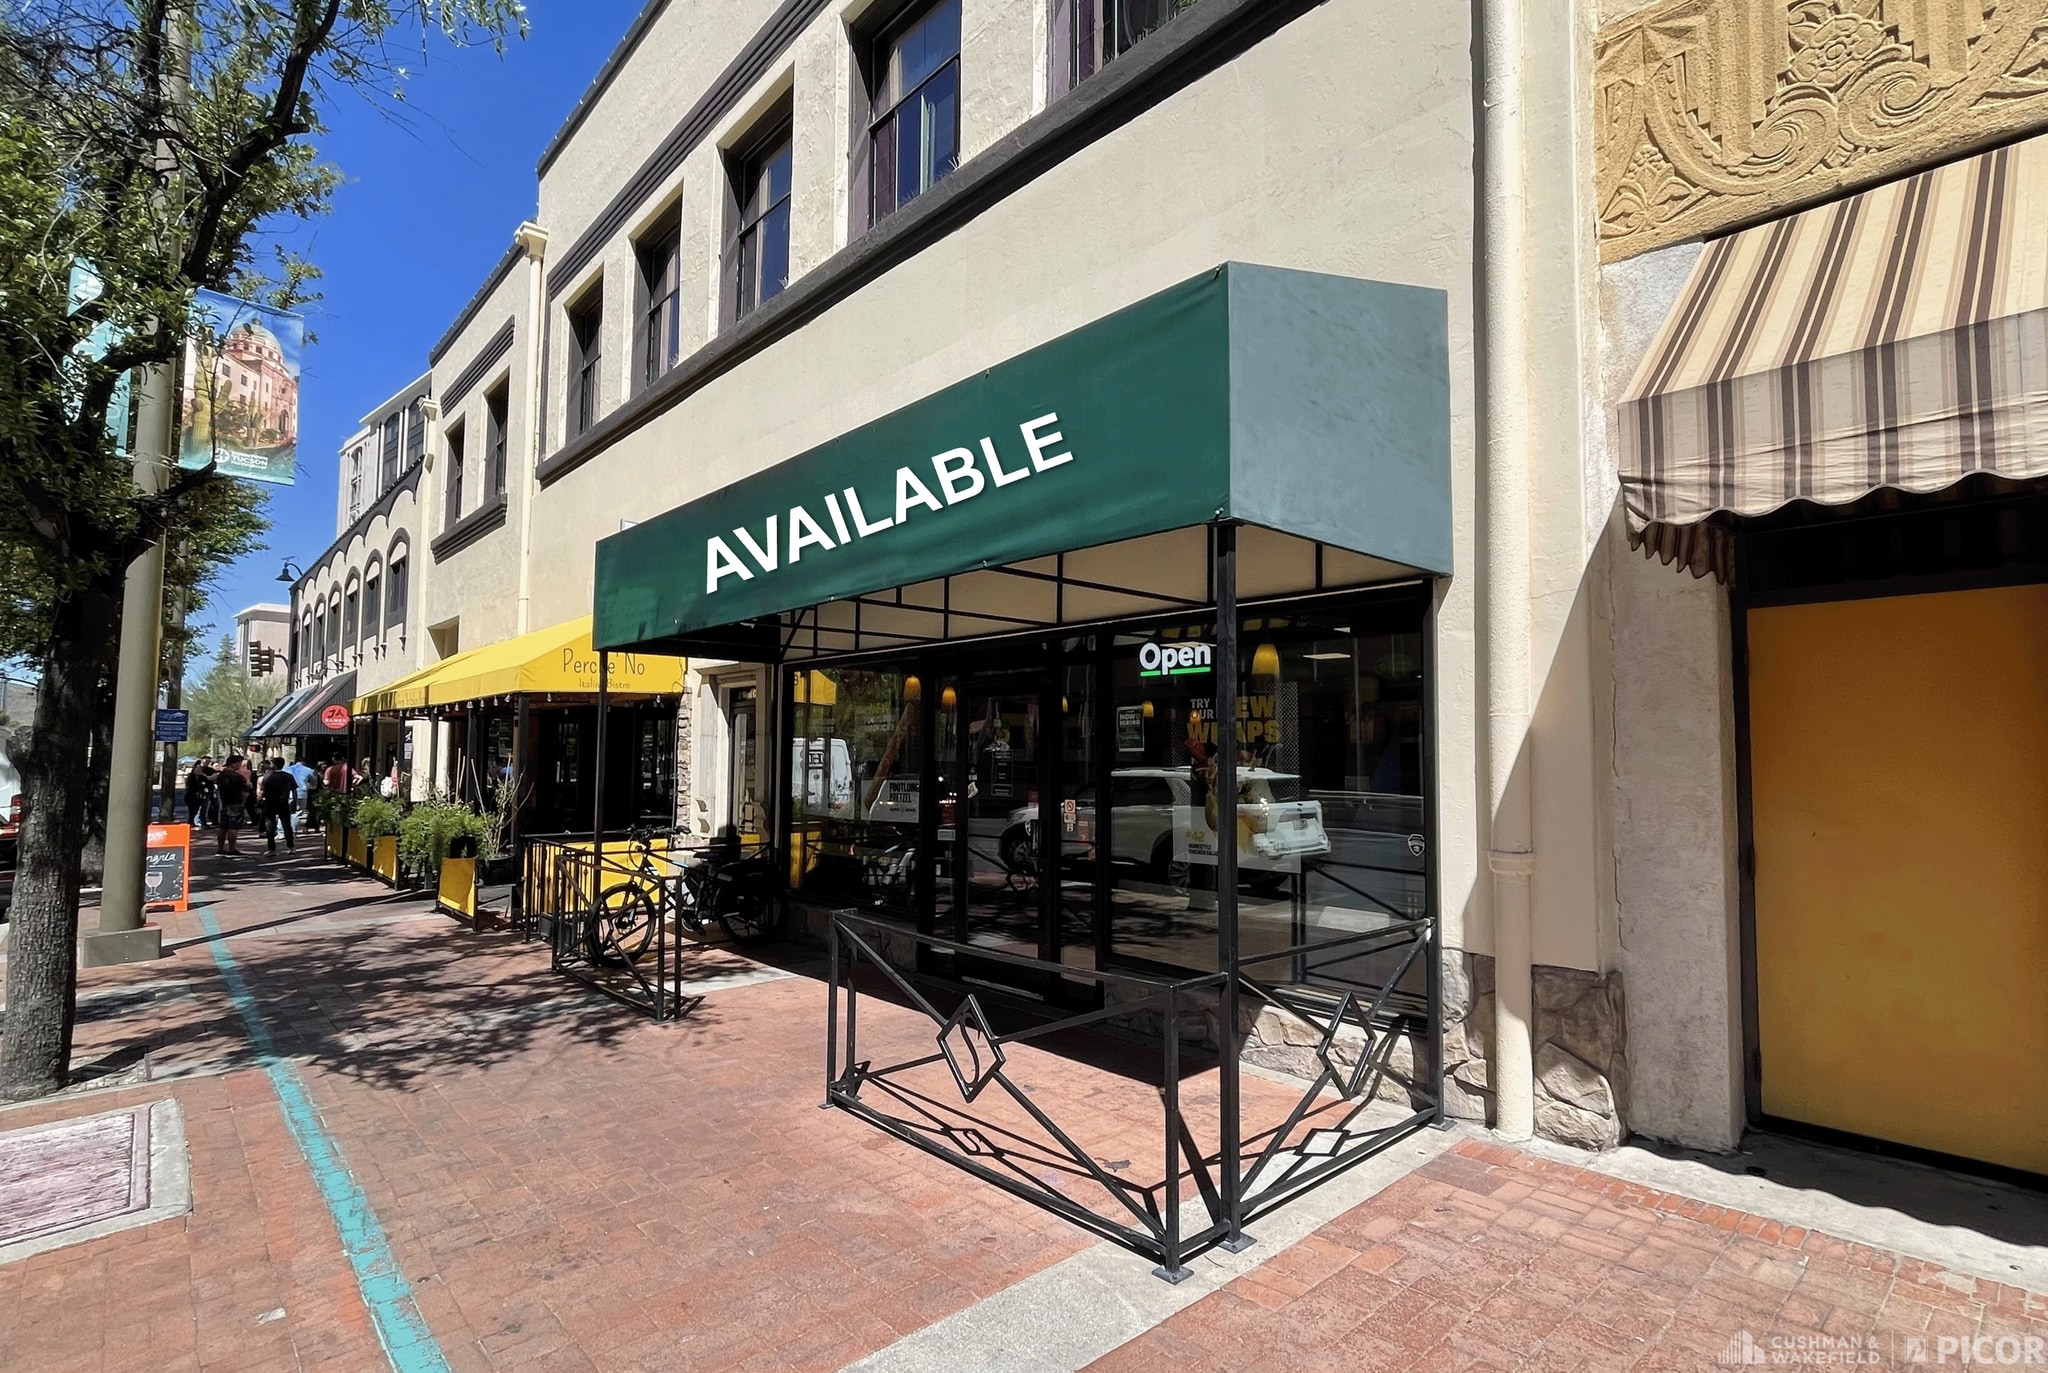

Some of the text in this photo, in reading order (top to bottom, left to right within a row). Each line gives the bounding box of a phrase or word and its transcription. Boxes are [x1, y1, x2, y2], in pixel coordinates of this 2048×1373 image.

[232, 455, 268, 467] TUCSON
[706, 412, 1073, 594] AVAILABLE
[625, 652, 645, 675] No
[1139, 642, 1211, 675] Open
[1190, 699, 1210, 709] TRY
[1187, 720, 1281, 743] WAPS
